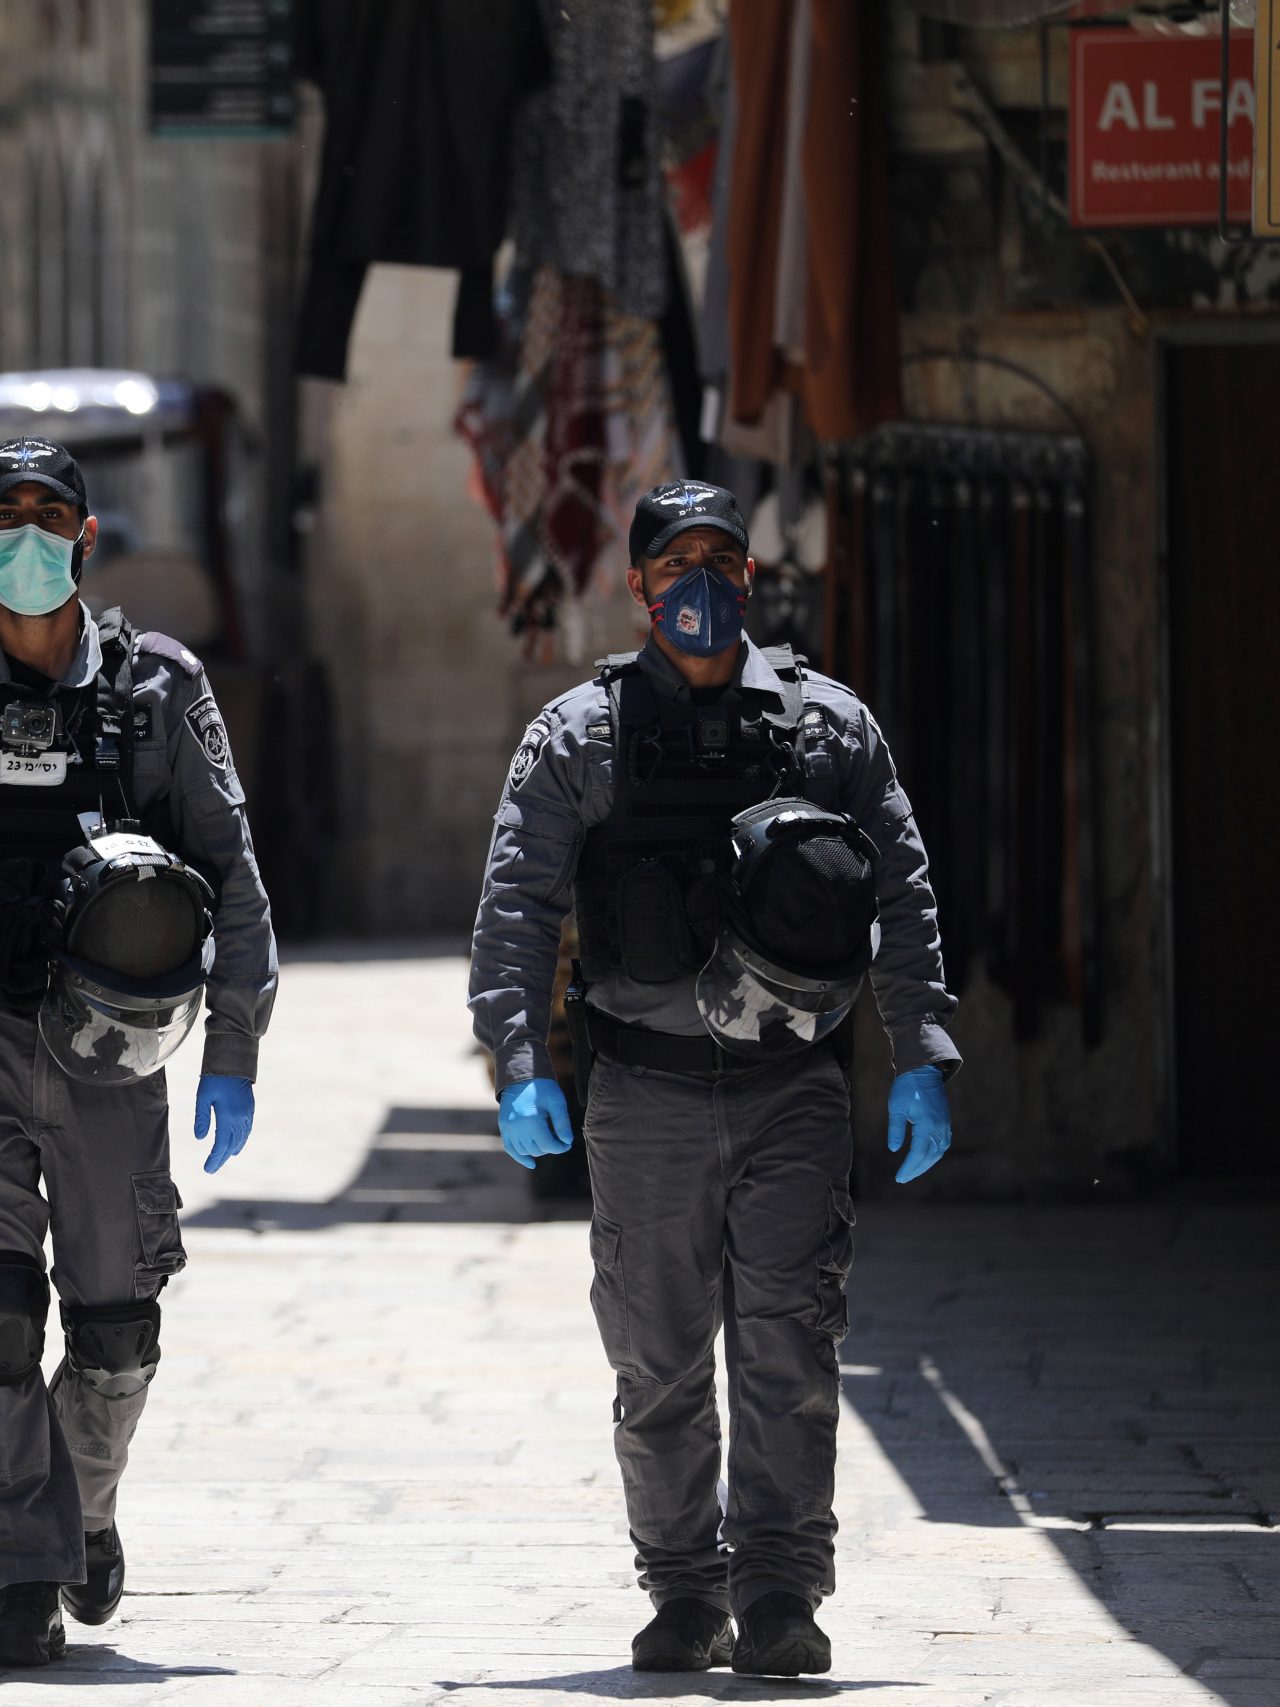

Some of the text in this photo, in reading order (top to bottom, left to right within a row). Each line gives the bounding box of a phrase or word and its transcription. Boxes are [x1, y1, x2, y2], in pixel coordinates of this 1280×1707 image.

[1098, 77, 1255, 131] AL FA
[6, 760, 21, 771] 23
